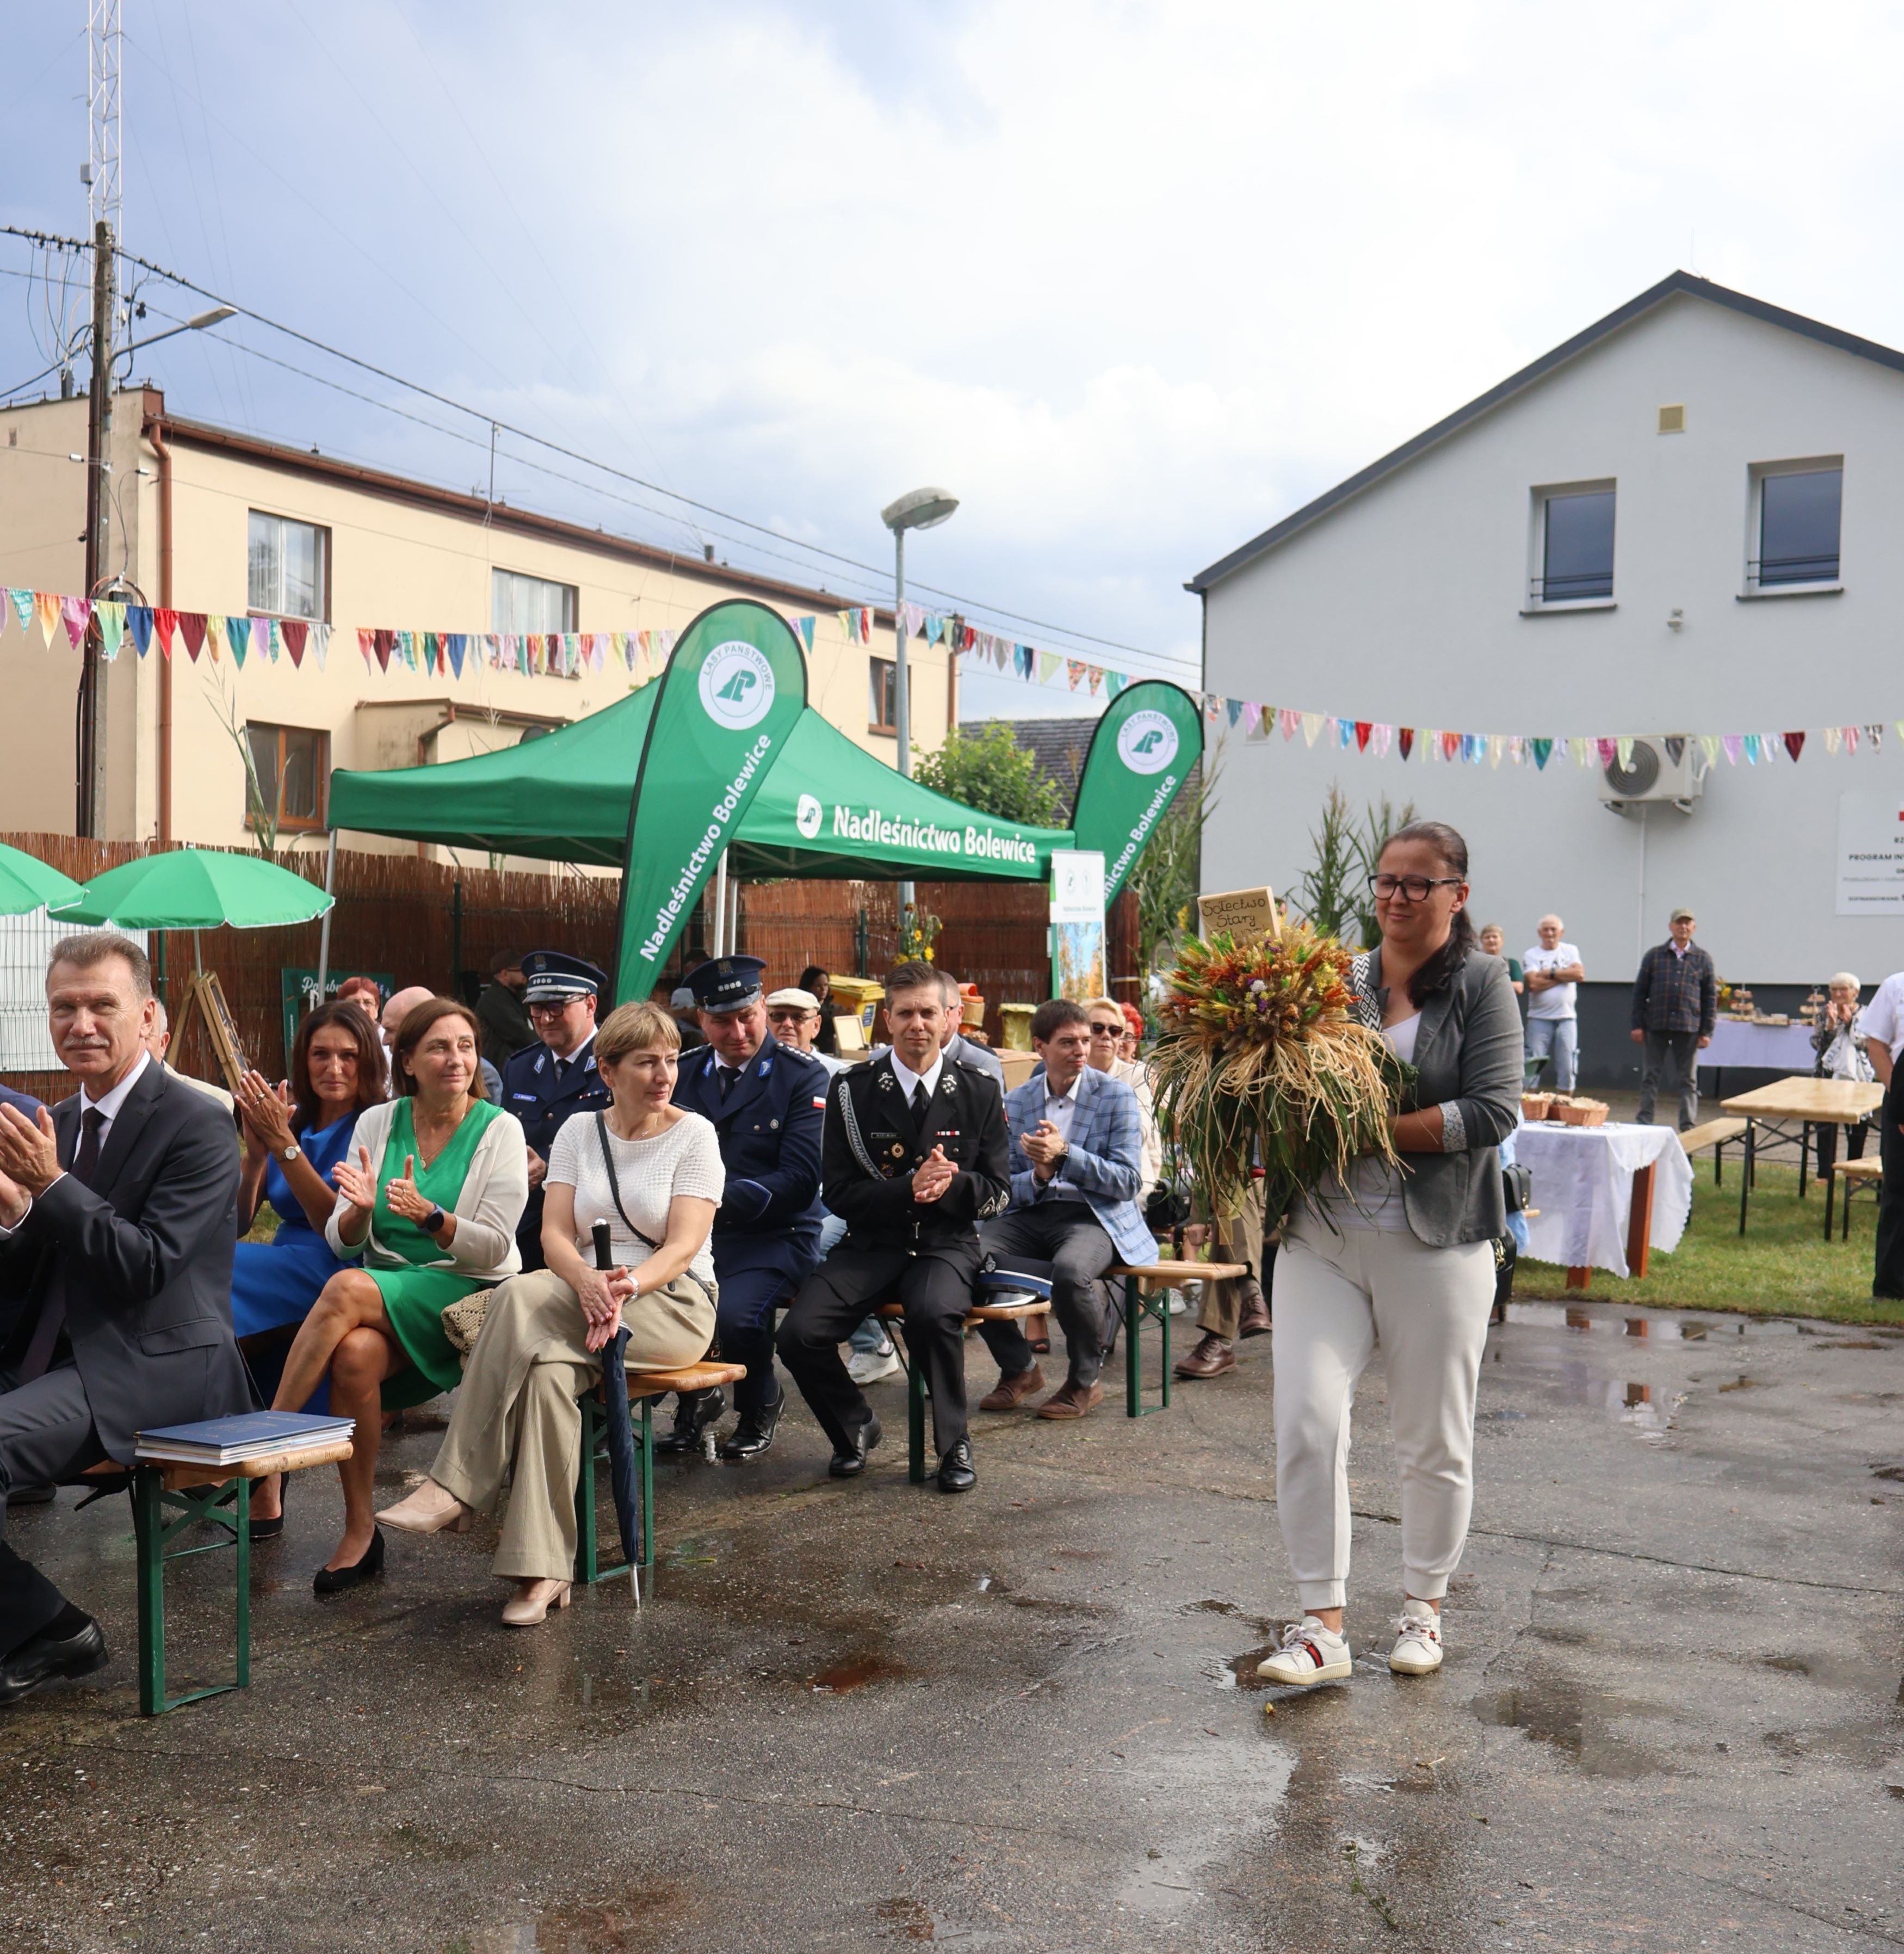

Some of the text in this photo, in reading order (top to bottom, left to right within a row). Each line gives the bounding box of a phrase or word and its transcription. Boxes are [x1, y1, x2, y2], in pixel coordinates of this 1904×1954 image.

[703, 650, 722, 675] LASY
[1121, 718, 1135, 738] LASY
[1129, 775, 1177, 842] Bolewice
[640, 735, 771, 962] Nadleśnictwo Bolewice
[833, 805, 1036, 863] Nadleśnictwo Bolewice
[1216, 914, 1256, 928] Stary
